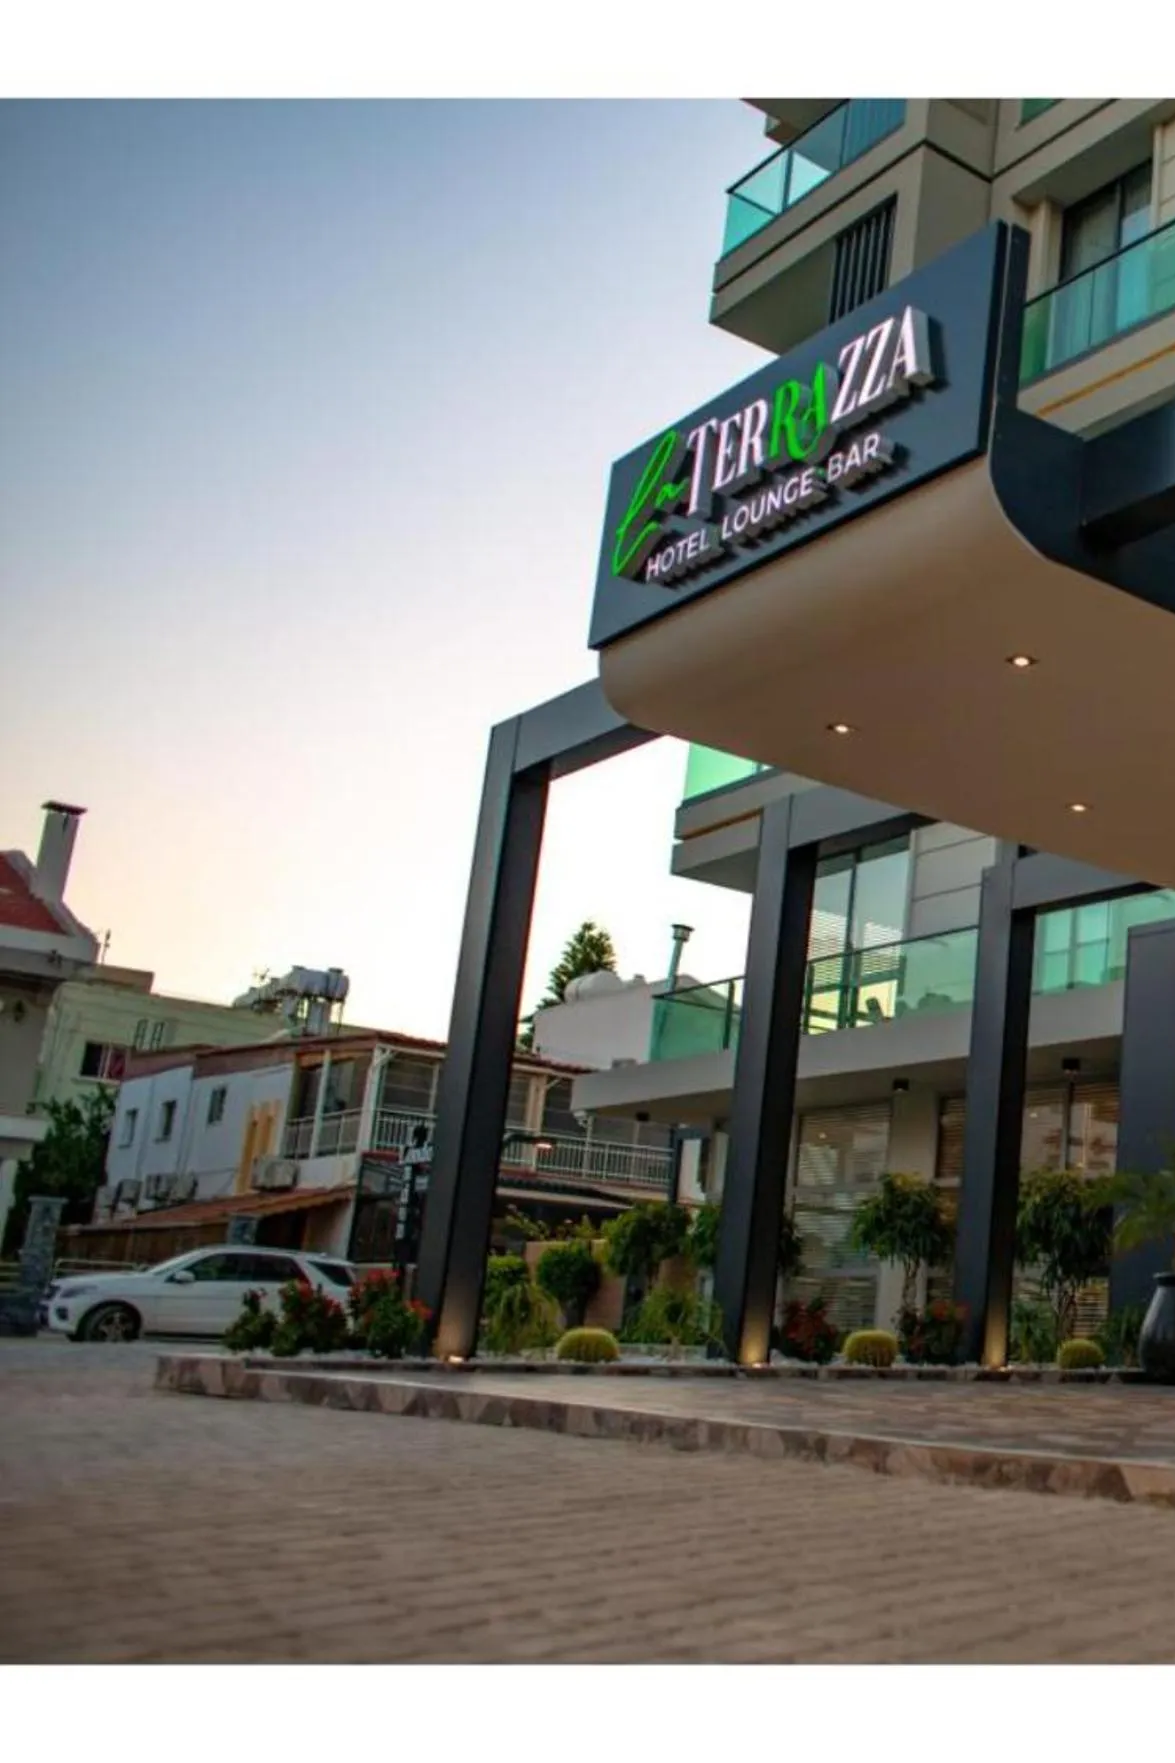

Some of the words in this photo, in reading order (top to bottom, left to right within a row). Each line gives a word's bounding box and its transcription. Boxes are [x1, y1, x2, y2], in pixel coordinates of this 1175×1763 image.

[686, 305, 917, 517] TERRAZZA
[646, 529, 710, 581] HOTEL
[721, 466, 816, 540] LOUNGE
[827, 432, 880, 483] BAR
